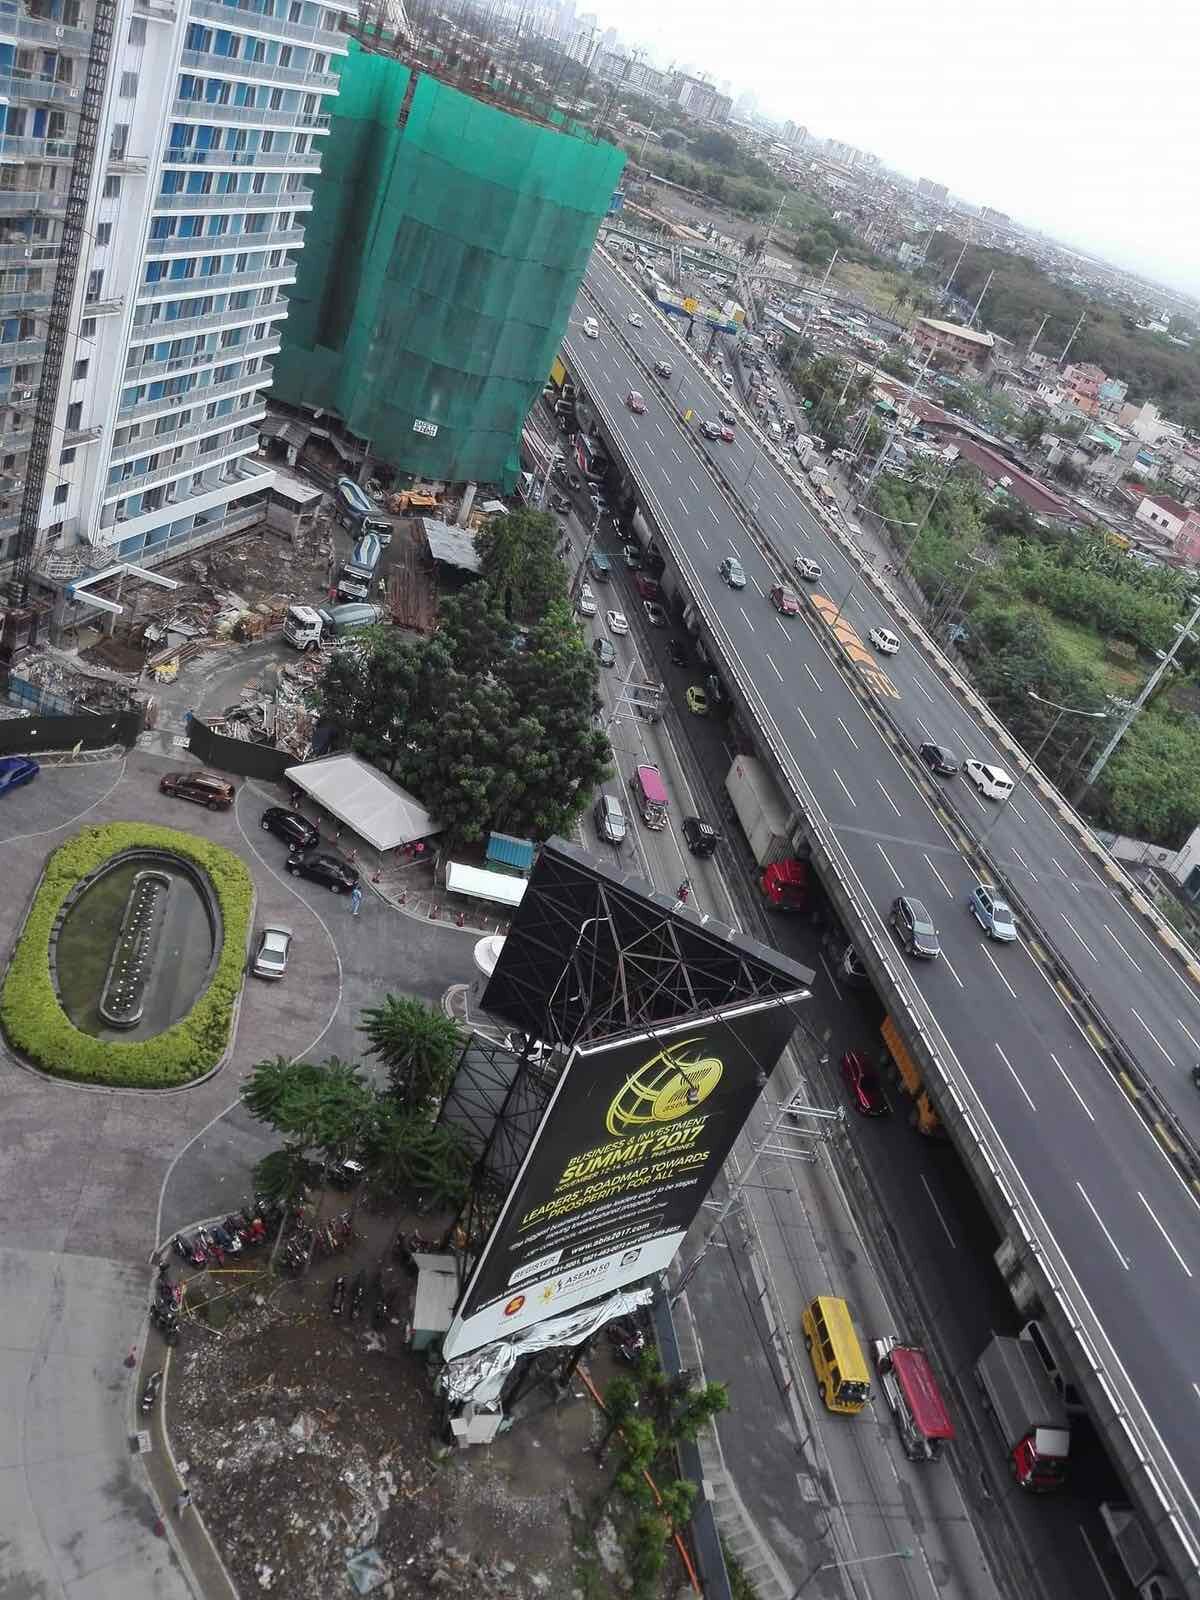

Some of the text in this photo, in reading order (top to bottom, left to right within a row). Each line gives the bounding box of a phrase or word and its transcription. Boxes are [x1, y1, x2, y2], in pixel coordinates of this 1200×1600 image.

[559, 1125, 705, 1184] SUMMIT 2017
[568, 1115, 711, 1167] BUSINESS & INVESTMENT
[522, 1187, 583, 1224] LEADERS'
[584, 1168, 649, 1197] ROADMAP
[650, 1151, 711, 1174] TOWARDS
[548, 1169, 675, 1220] PROSPERITY FOR ALL
[513, 1255, 557, 1279] REGISTER
[564, 1267, 599, 1284] ASEAN
